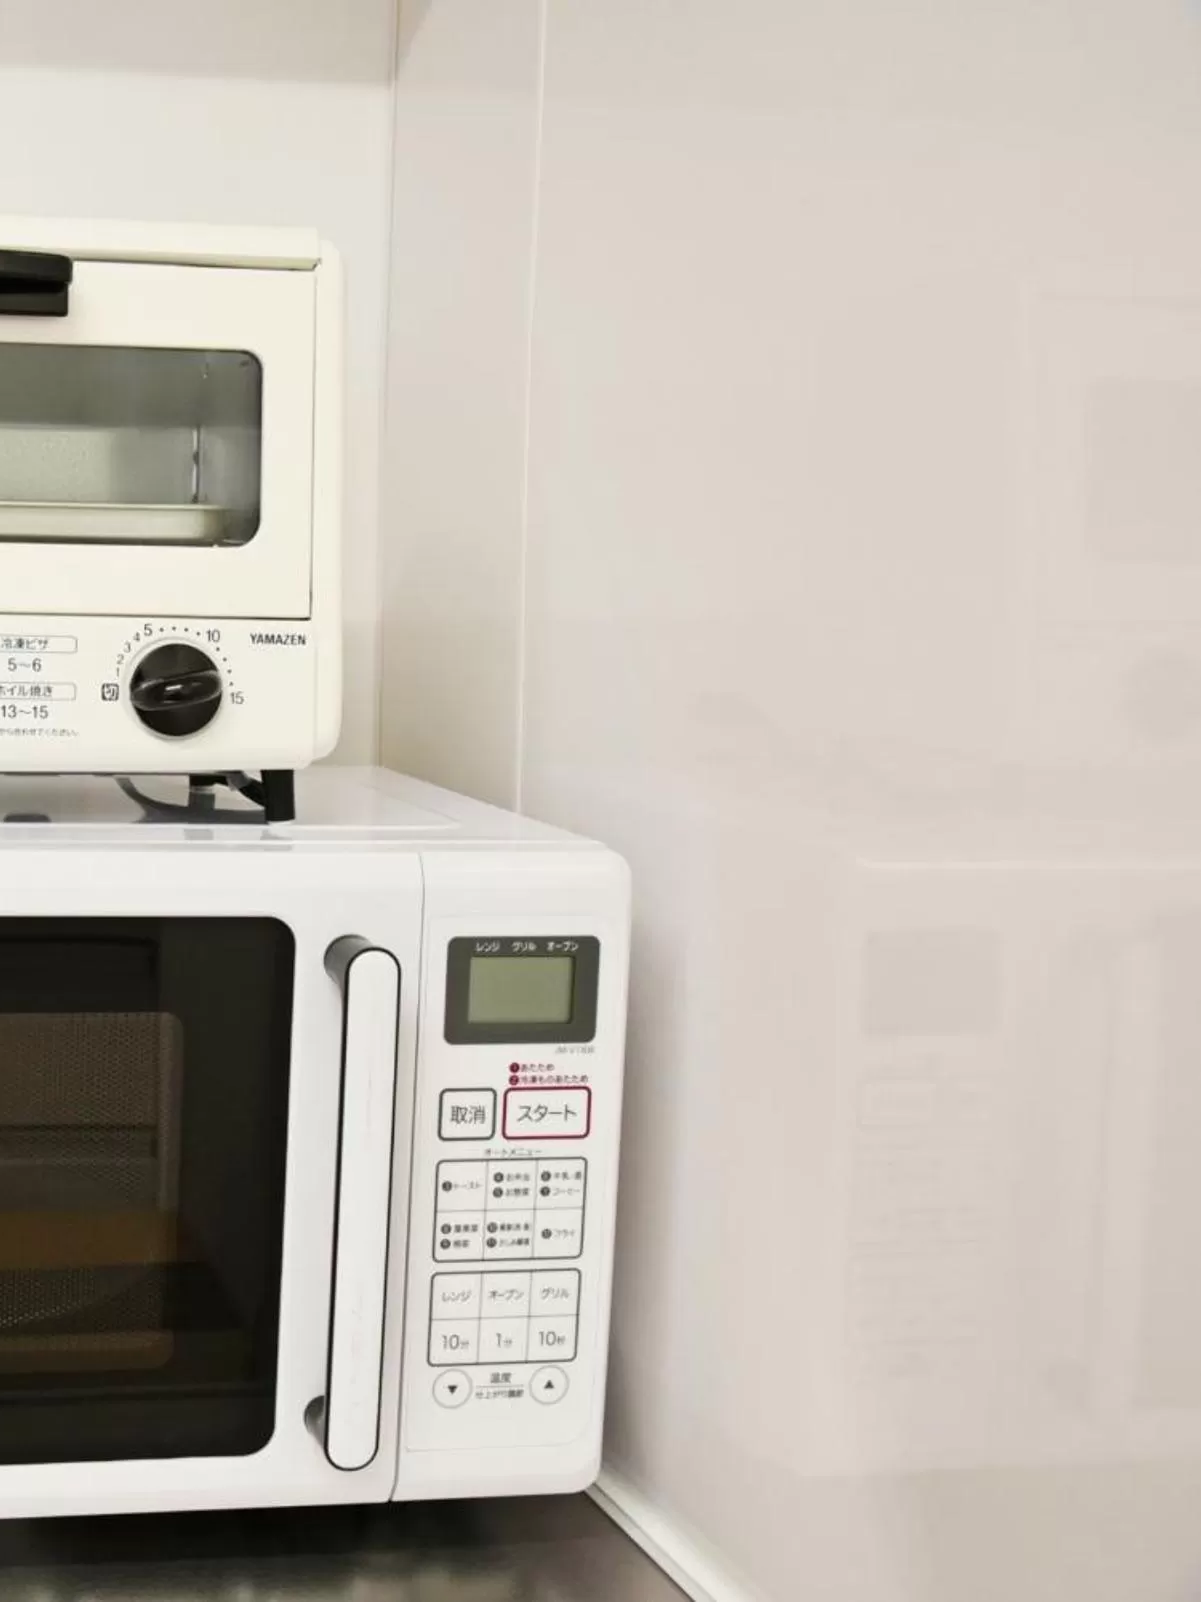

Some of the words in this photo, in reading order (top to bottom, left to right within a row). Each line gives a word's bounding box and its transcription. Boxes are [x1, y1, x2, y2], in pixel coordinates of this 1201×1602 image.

[133, 632, 141, 642] 4
[144, 624, 153, 637] 5
[206, 629, 221, 643] 10
[250, 632, 307, 647] YAMAZEN
[123, 642, 131, 653] 3
[116, 654, 125, 665] 2
[230, 692, 244, 705] 15
[476, 942, 501, 952] レンジ
[511, 941, 537, 951] グリル
[547, 941, 579, 951] オープン
[450, 1105, 486, 1124] 取消
[516, 1104, 577, 1122] スタート
[441, 1290, 472, 1302] レンジ
[488, 1288, 524, 1300] オープン
[541, 1287, 570, 1300] グリル
